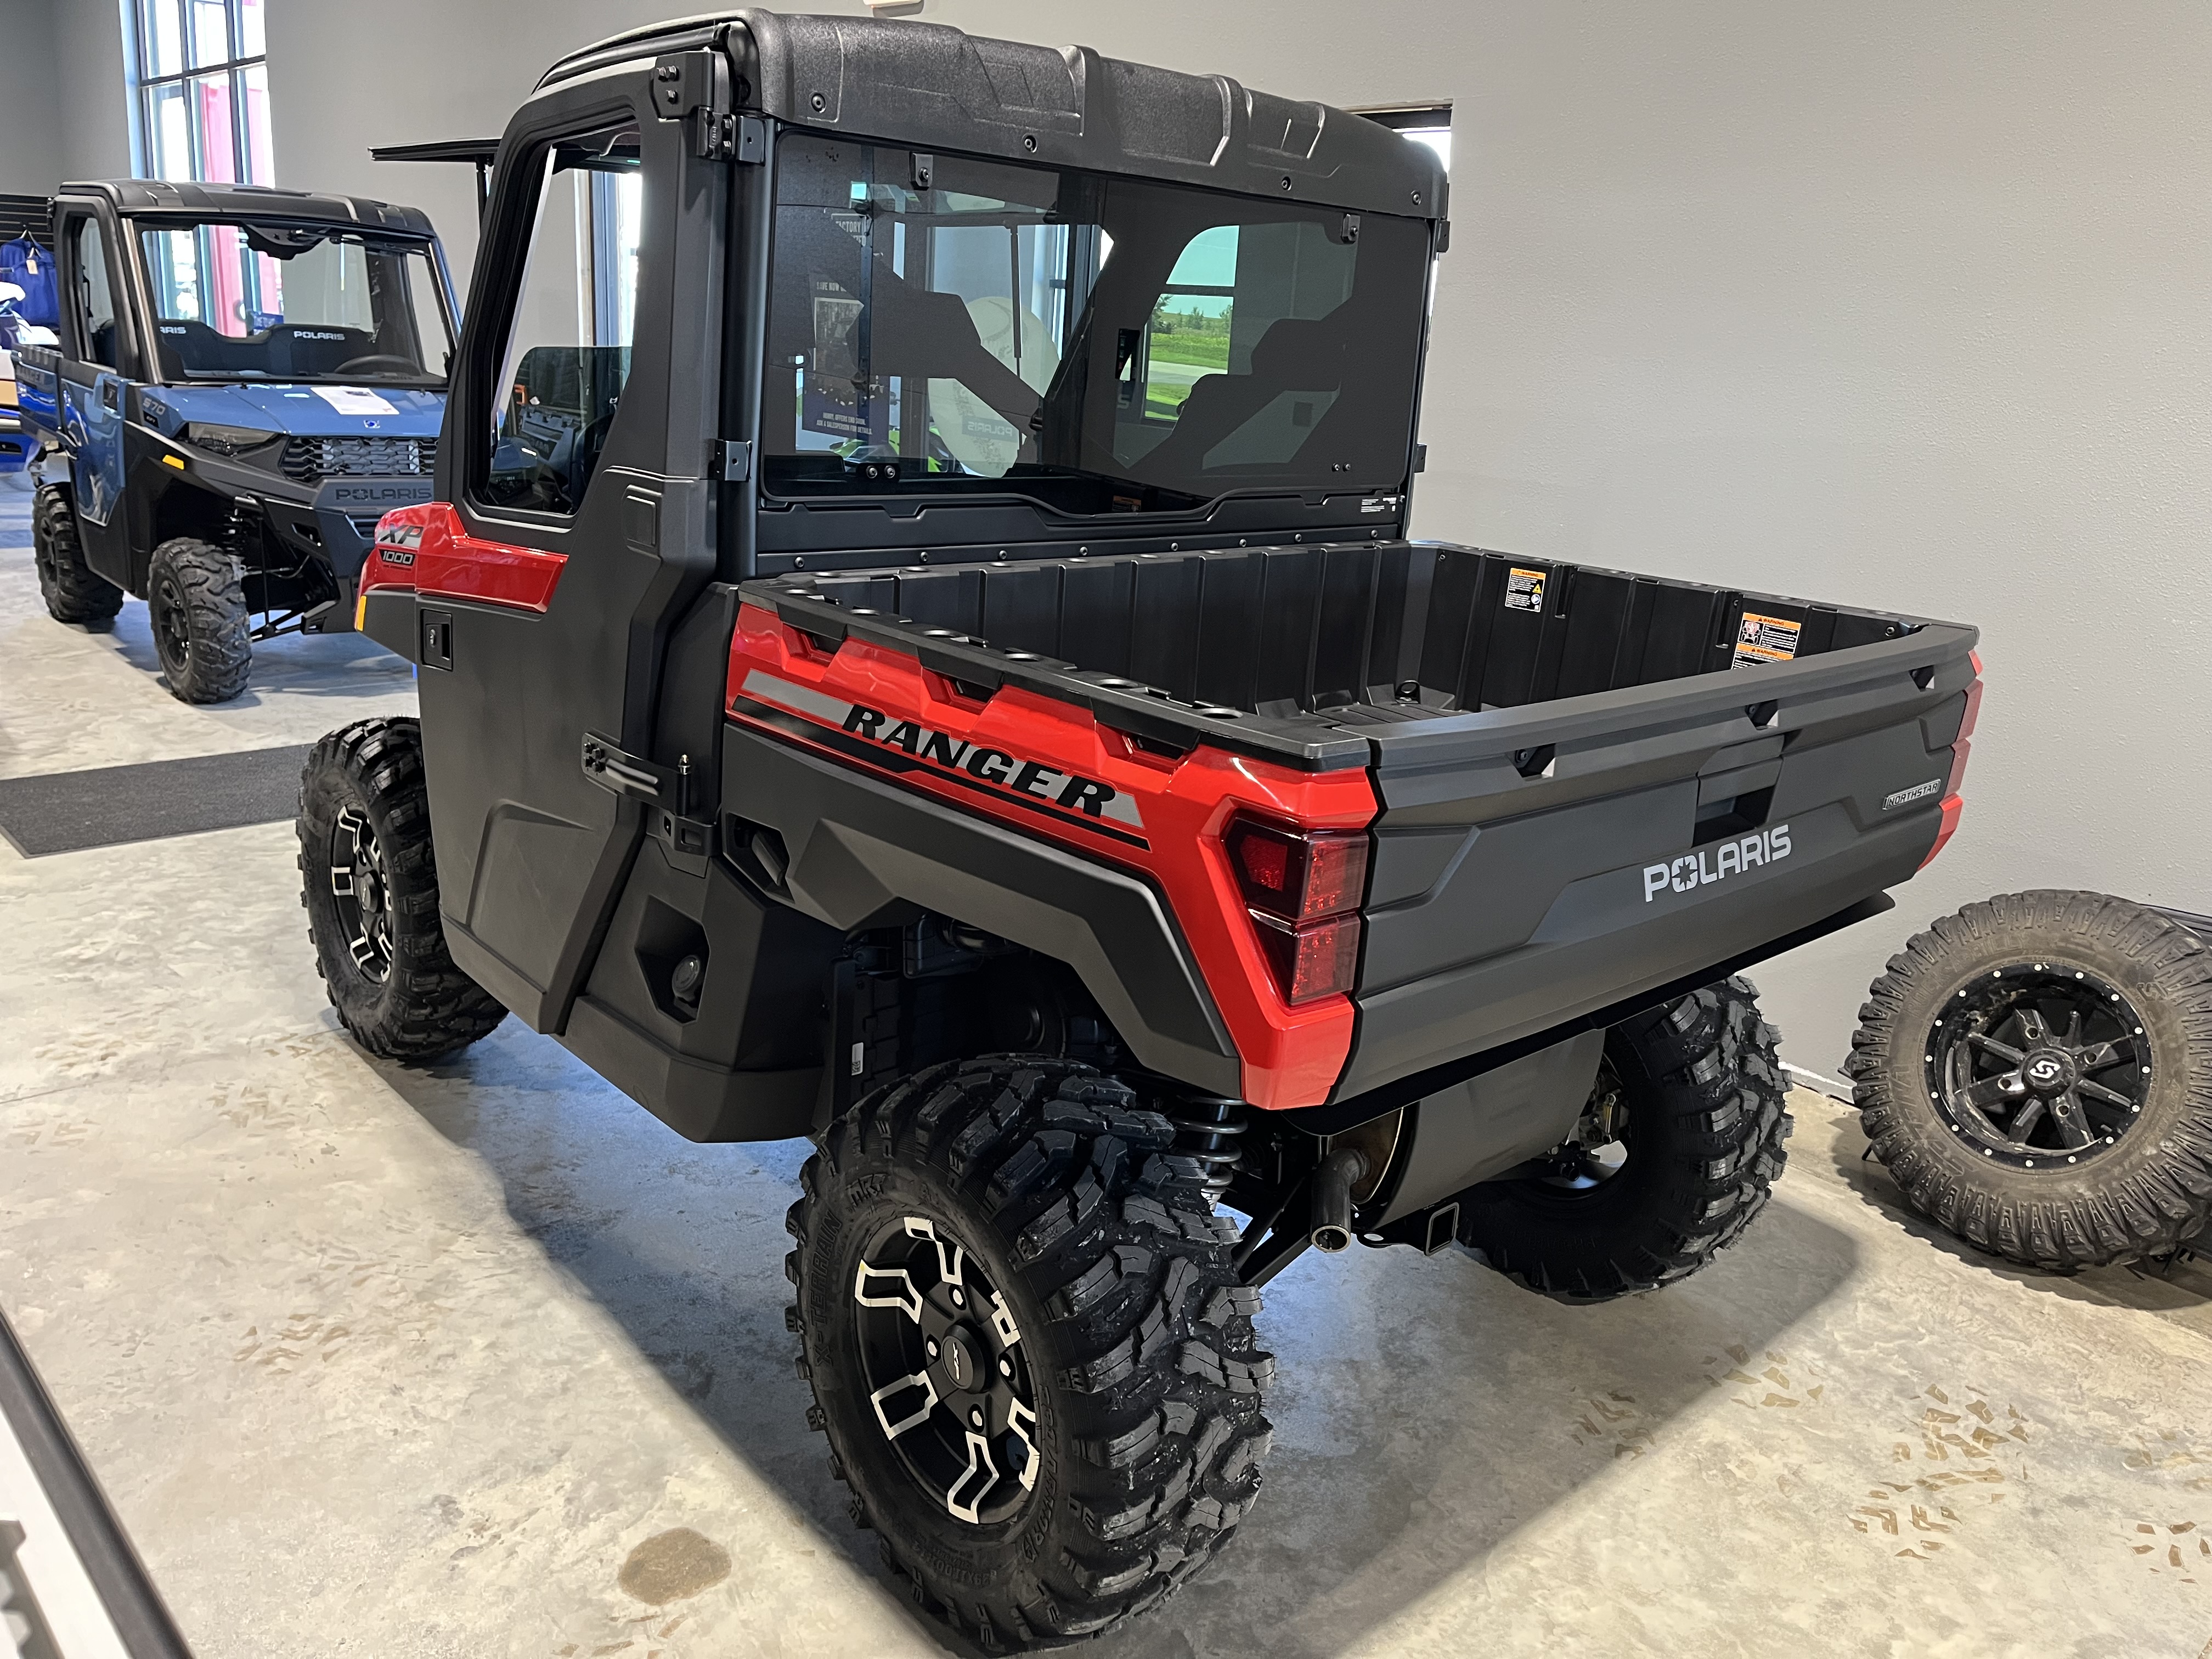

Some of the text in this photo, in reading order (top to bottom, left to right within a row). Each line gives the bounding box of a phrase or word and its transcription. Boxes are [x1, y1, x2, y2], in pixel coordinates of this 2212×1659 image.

[294, 331, 345, 341] POLARIS
[336, 488, 432, 500] POLARIS
[380, 523, 424, 544] XP
[382, 550, 413, 565] 1000
[842, 704, 1116, 818] RANGER
[1889, 782, 1938, 806] NORTHSTAR
[1643, 824, 1792, 902] POLARIS
[809, 1209, 843, 1367] X-TERRAIN
